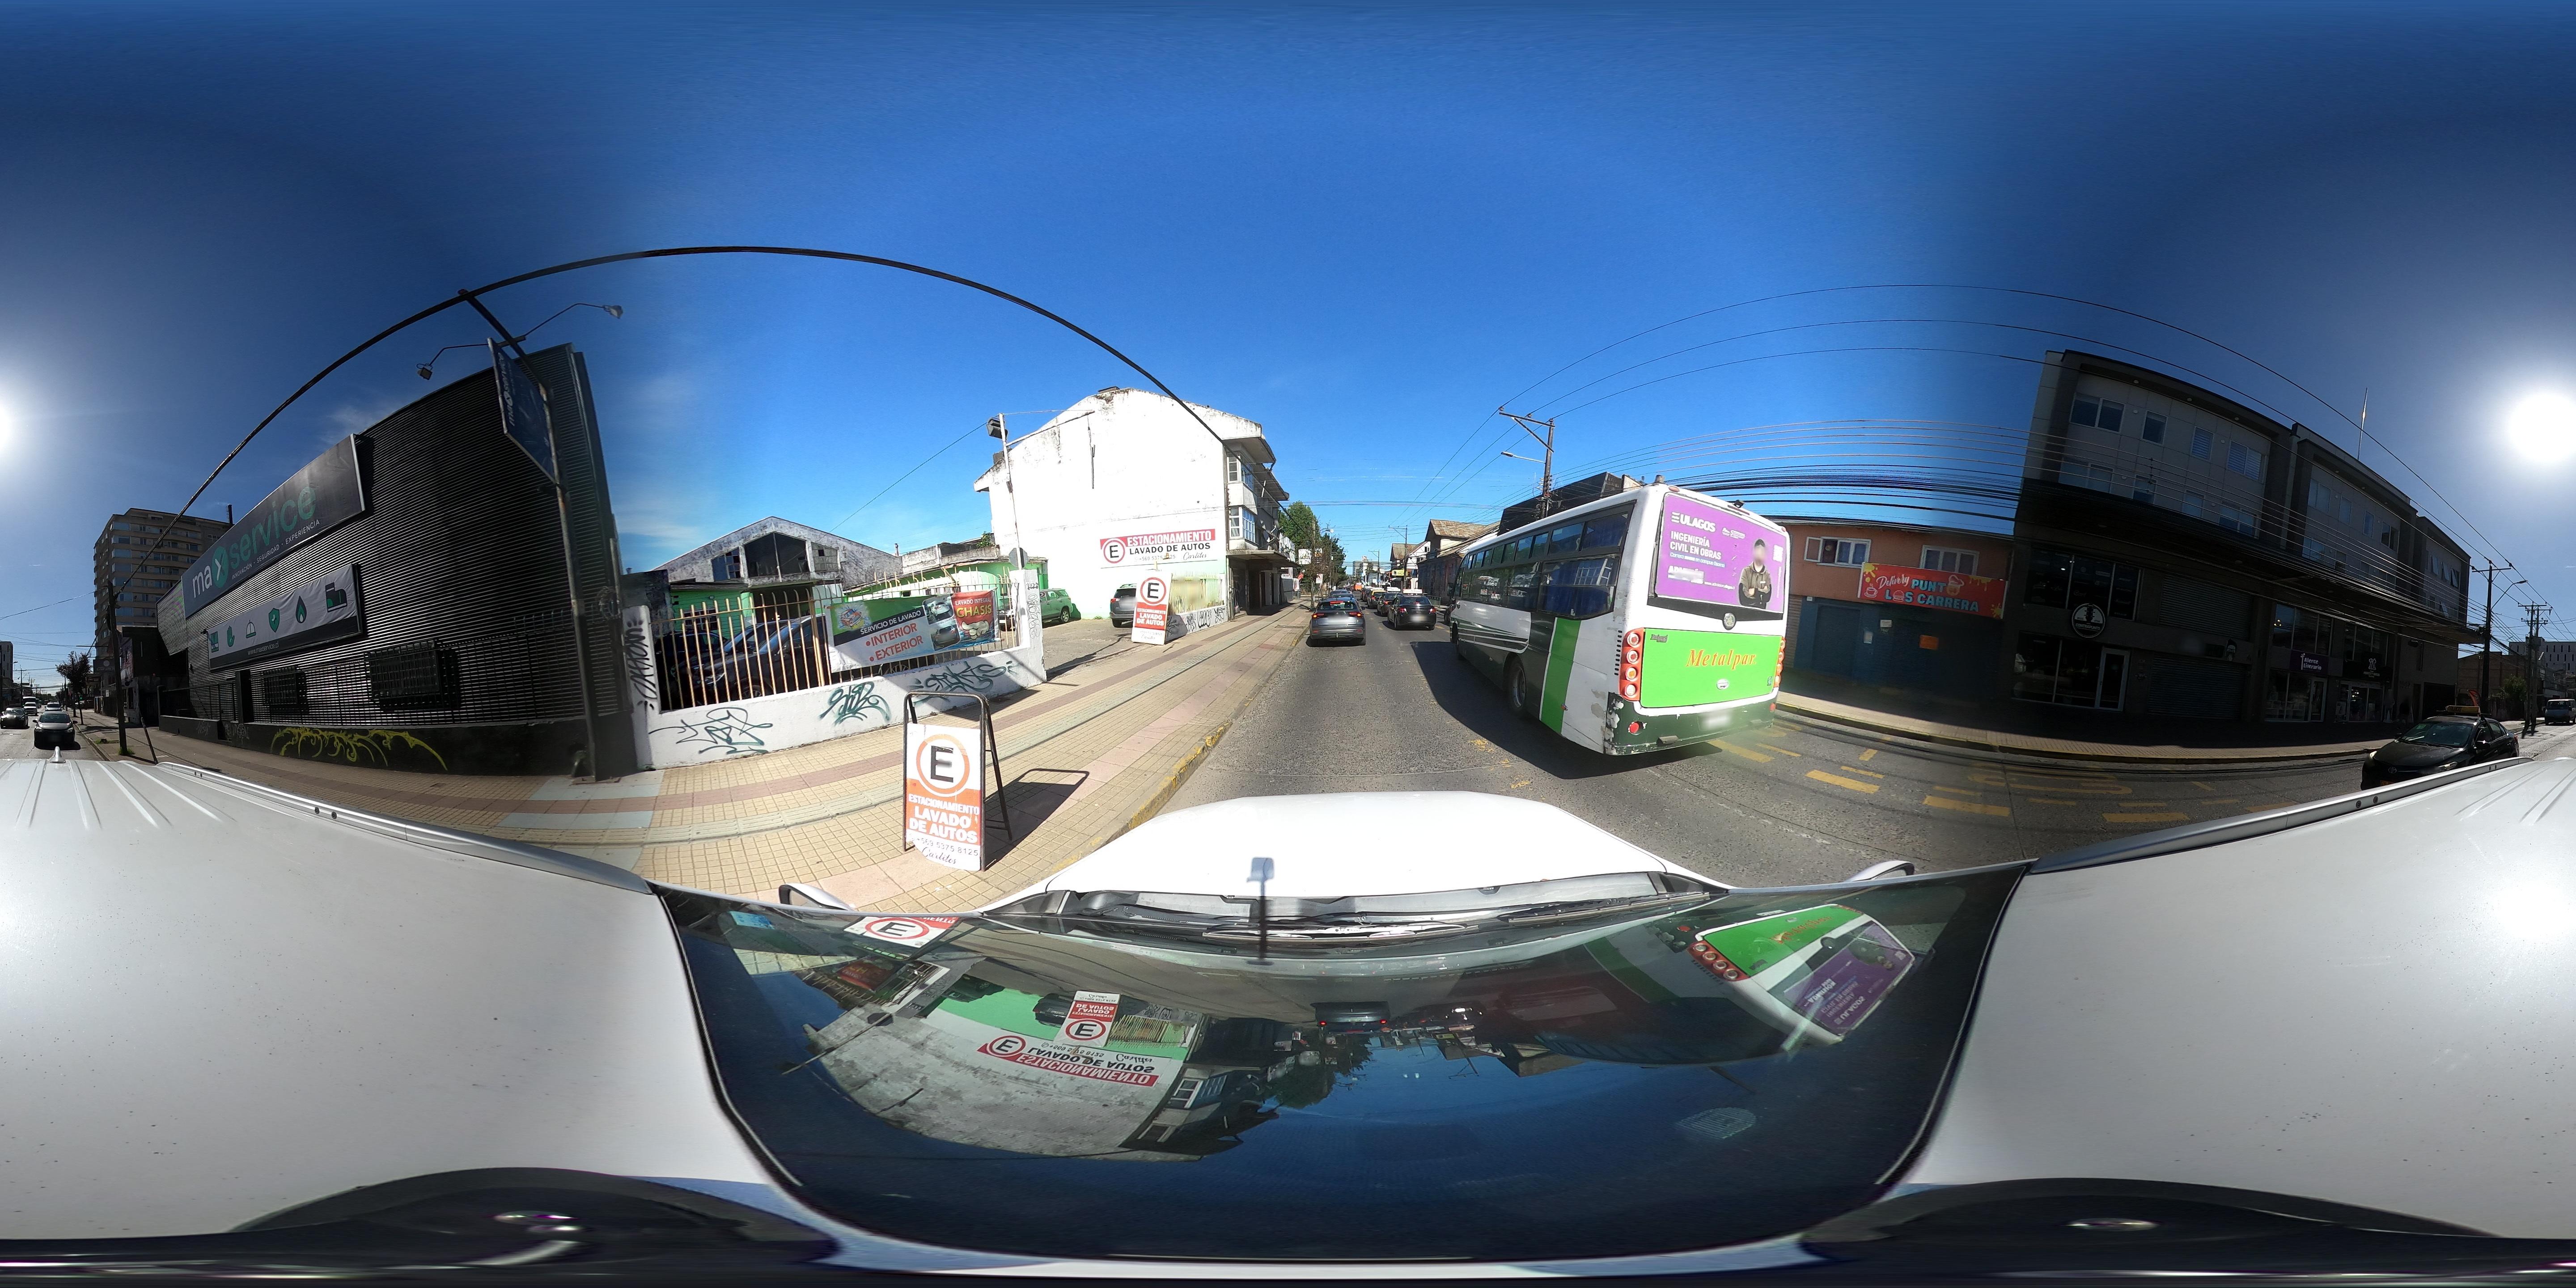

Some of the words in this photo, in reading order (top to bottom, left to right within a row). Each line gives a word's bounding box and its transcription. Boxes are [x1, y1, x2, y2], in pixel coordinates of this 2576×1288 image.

[1680, 514, 1716, 532] ULAGOS
[1127, 531, 1212, 547] ESTACIONAMIENTO
[1670, 531, 1710, 547] INGENIERÍA
[231, 564, 252, 580] INNOVACIÓN
[257, 544, 280, 564] SEGURIDAD
[285, 519, 320, 545] EXPERIENCIA
[1110, 545, 1119, 558] E
[1130, 546, 1163, 555] LAVADO
[1181, 542, 1210, 551] AUTOS
[1670, 542, 1688, 553] CIVIL
[1690, 546, 1699, 555] EN
[1700, 548, 1721, 560] OBRAS
[1147, 583, 1159, 598] E
[1877, 574, 1910, 589] Delivery
[956, 604, 991, 618] CHASIS
[1917, 593, 1979, 612] CARRERA
[860, 621, 888, 635] SERVICIO
[898, 610, 921, 622] LAVADO
[871, 623, 917, 647] INTERIOR
[874, 635, 924, 661] EXTERIOR
[1686, 649, 1756, 670] Metalpar
[931, 746, 953, 783] E
[908, 794, 980, 815] ESTACIONAMIENTO
[914, 805, 971, 829] LAVADO
[909, 818, 927, 833] DE
[930, 825, 978, 843] AUTOS
[936, 842, 954, 852] 5375
[958, 847, 978, 856] 8125
